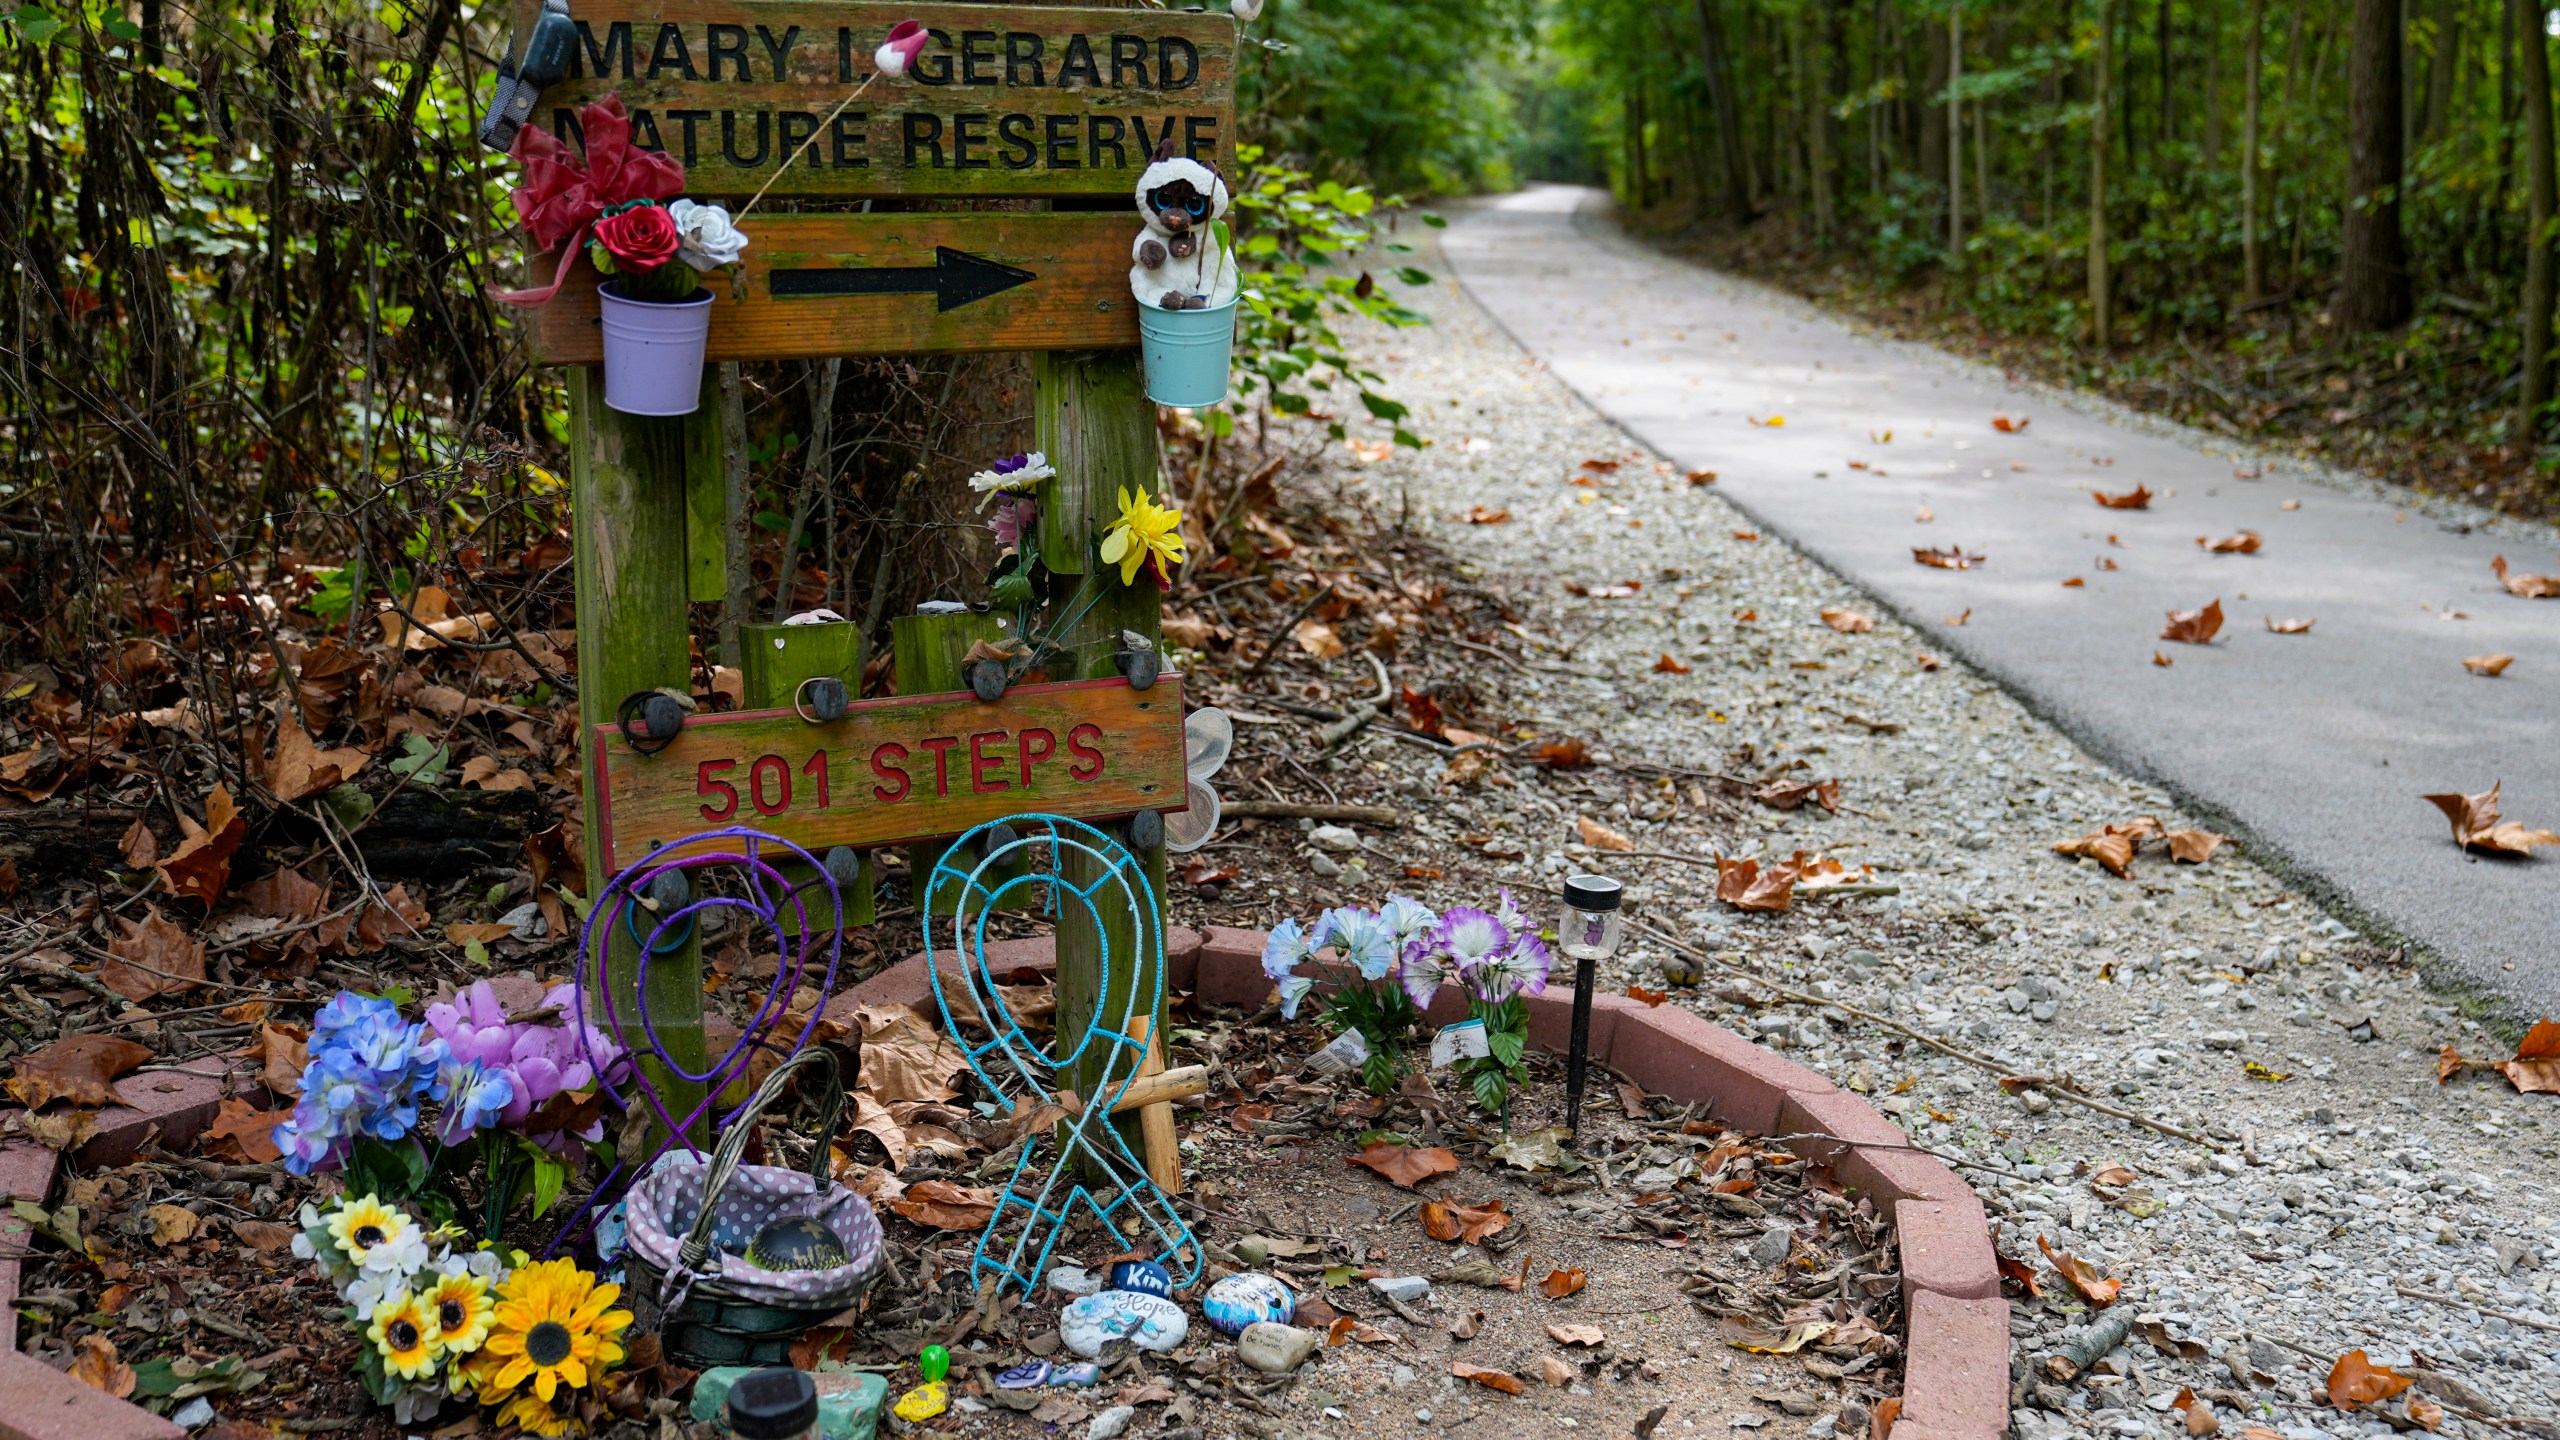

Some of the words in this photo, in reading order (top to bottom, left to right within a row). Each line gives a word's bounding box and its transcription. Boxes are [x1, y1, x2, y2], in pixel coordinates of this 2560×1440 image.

[570, 20, 800, 82] MARY
[908, 28, 1199, 90] GERARD
[902, 112, 1218, 168] RESERVE
[696, 749, 830, 822] 501
[871, 722, 1106, 802] STEPS
[1117, 1293, 1177, 1319] Hope
